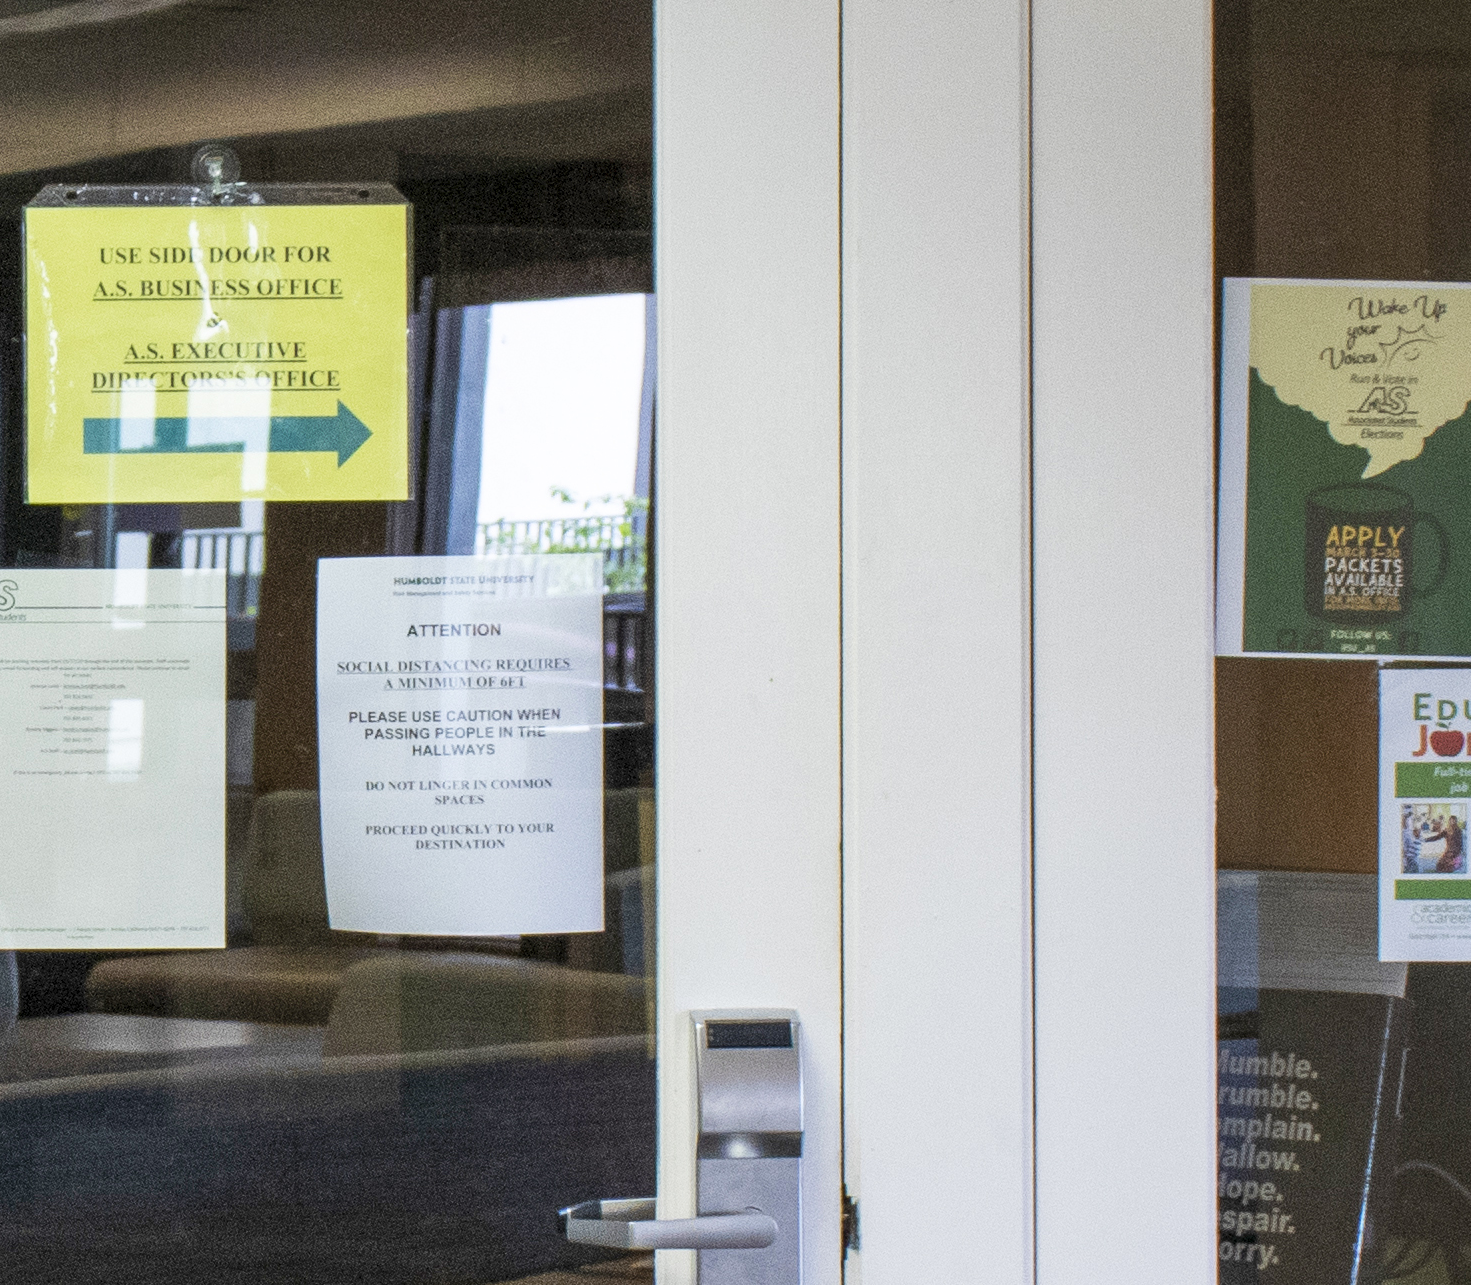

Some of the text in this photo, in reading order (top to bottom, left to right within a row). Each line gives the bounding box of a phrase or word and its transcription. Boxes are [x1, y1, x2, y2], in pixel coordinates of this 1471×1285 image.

[99, 246, 331, 265] USE SIDE DOOR FOR
[93, 279, 343, 297] A.S. BUSINESS OFFICE
[1347, 295, 1447, 323] Wake Up
[124, 342, 307, 360] A.S. EXECUTIVE
[1326, 525, 1405, 547] APPLY
[1324, 557, 1404, 573] PACKETS
[1324, 573, 1404, 587] AVAILABLE
[407, 624, 501, 637] ATTENTION
[337, 658, 571, 672] SOCIAL DISTANCING REQUIRES
[349, 709, 561, 723] PLEASE USE CAUTION WHEN
[365, 726, 546, 740] PASSING PEOPLE IN THE
[412, 744, 495, 756] HALLWAYS
[415, 839, 505, 850] DESTINATION
